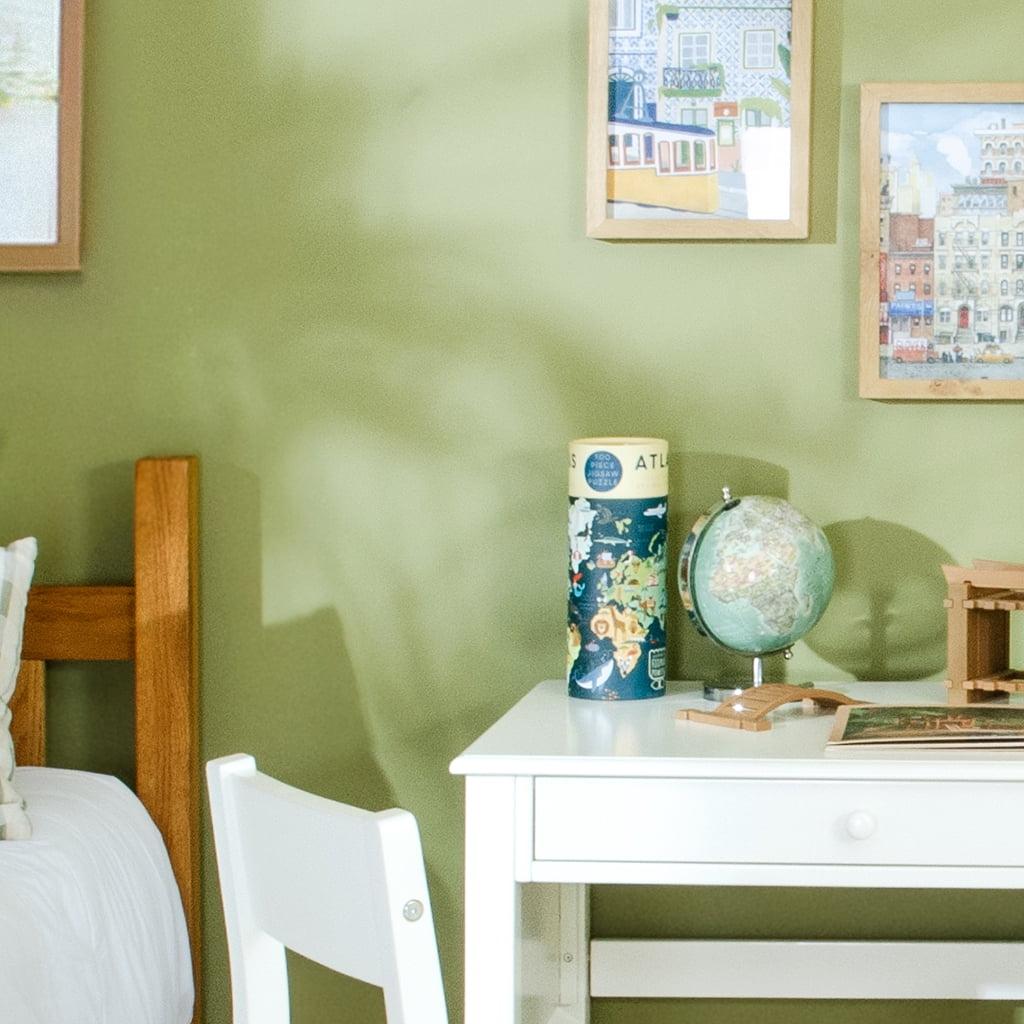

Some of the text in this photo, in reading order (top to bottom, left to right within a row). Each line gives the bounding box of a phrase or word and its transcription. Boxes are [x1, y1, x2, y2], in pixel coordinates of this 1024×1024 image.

[590, 461, 615, 469] PIECE
[636, 452, 669, 470] ATL
[588, 469, 619, 478] JIGSAW
[588, 478, 618, 487] PUZZLE
